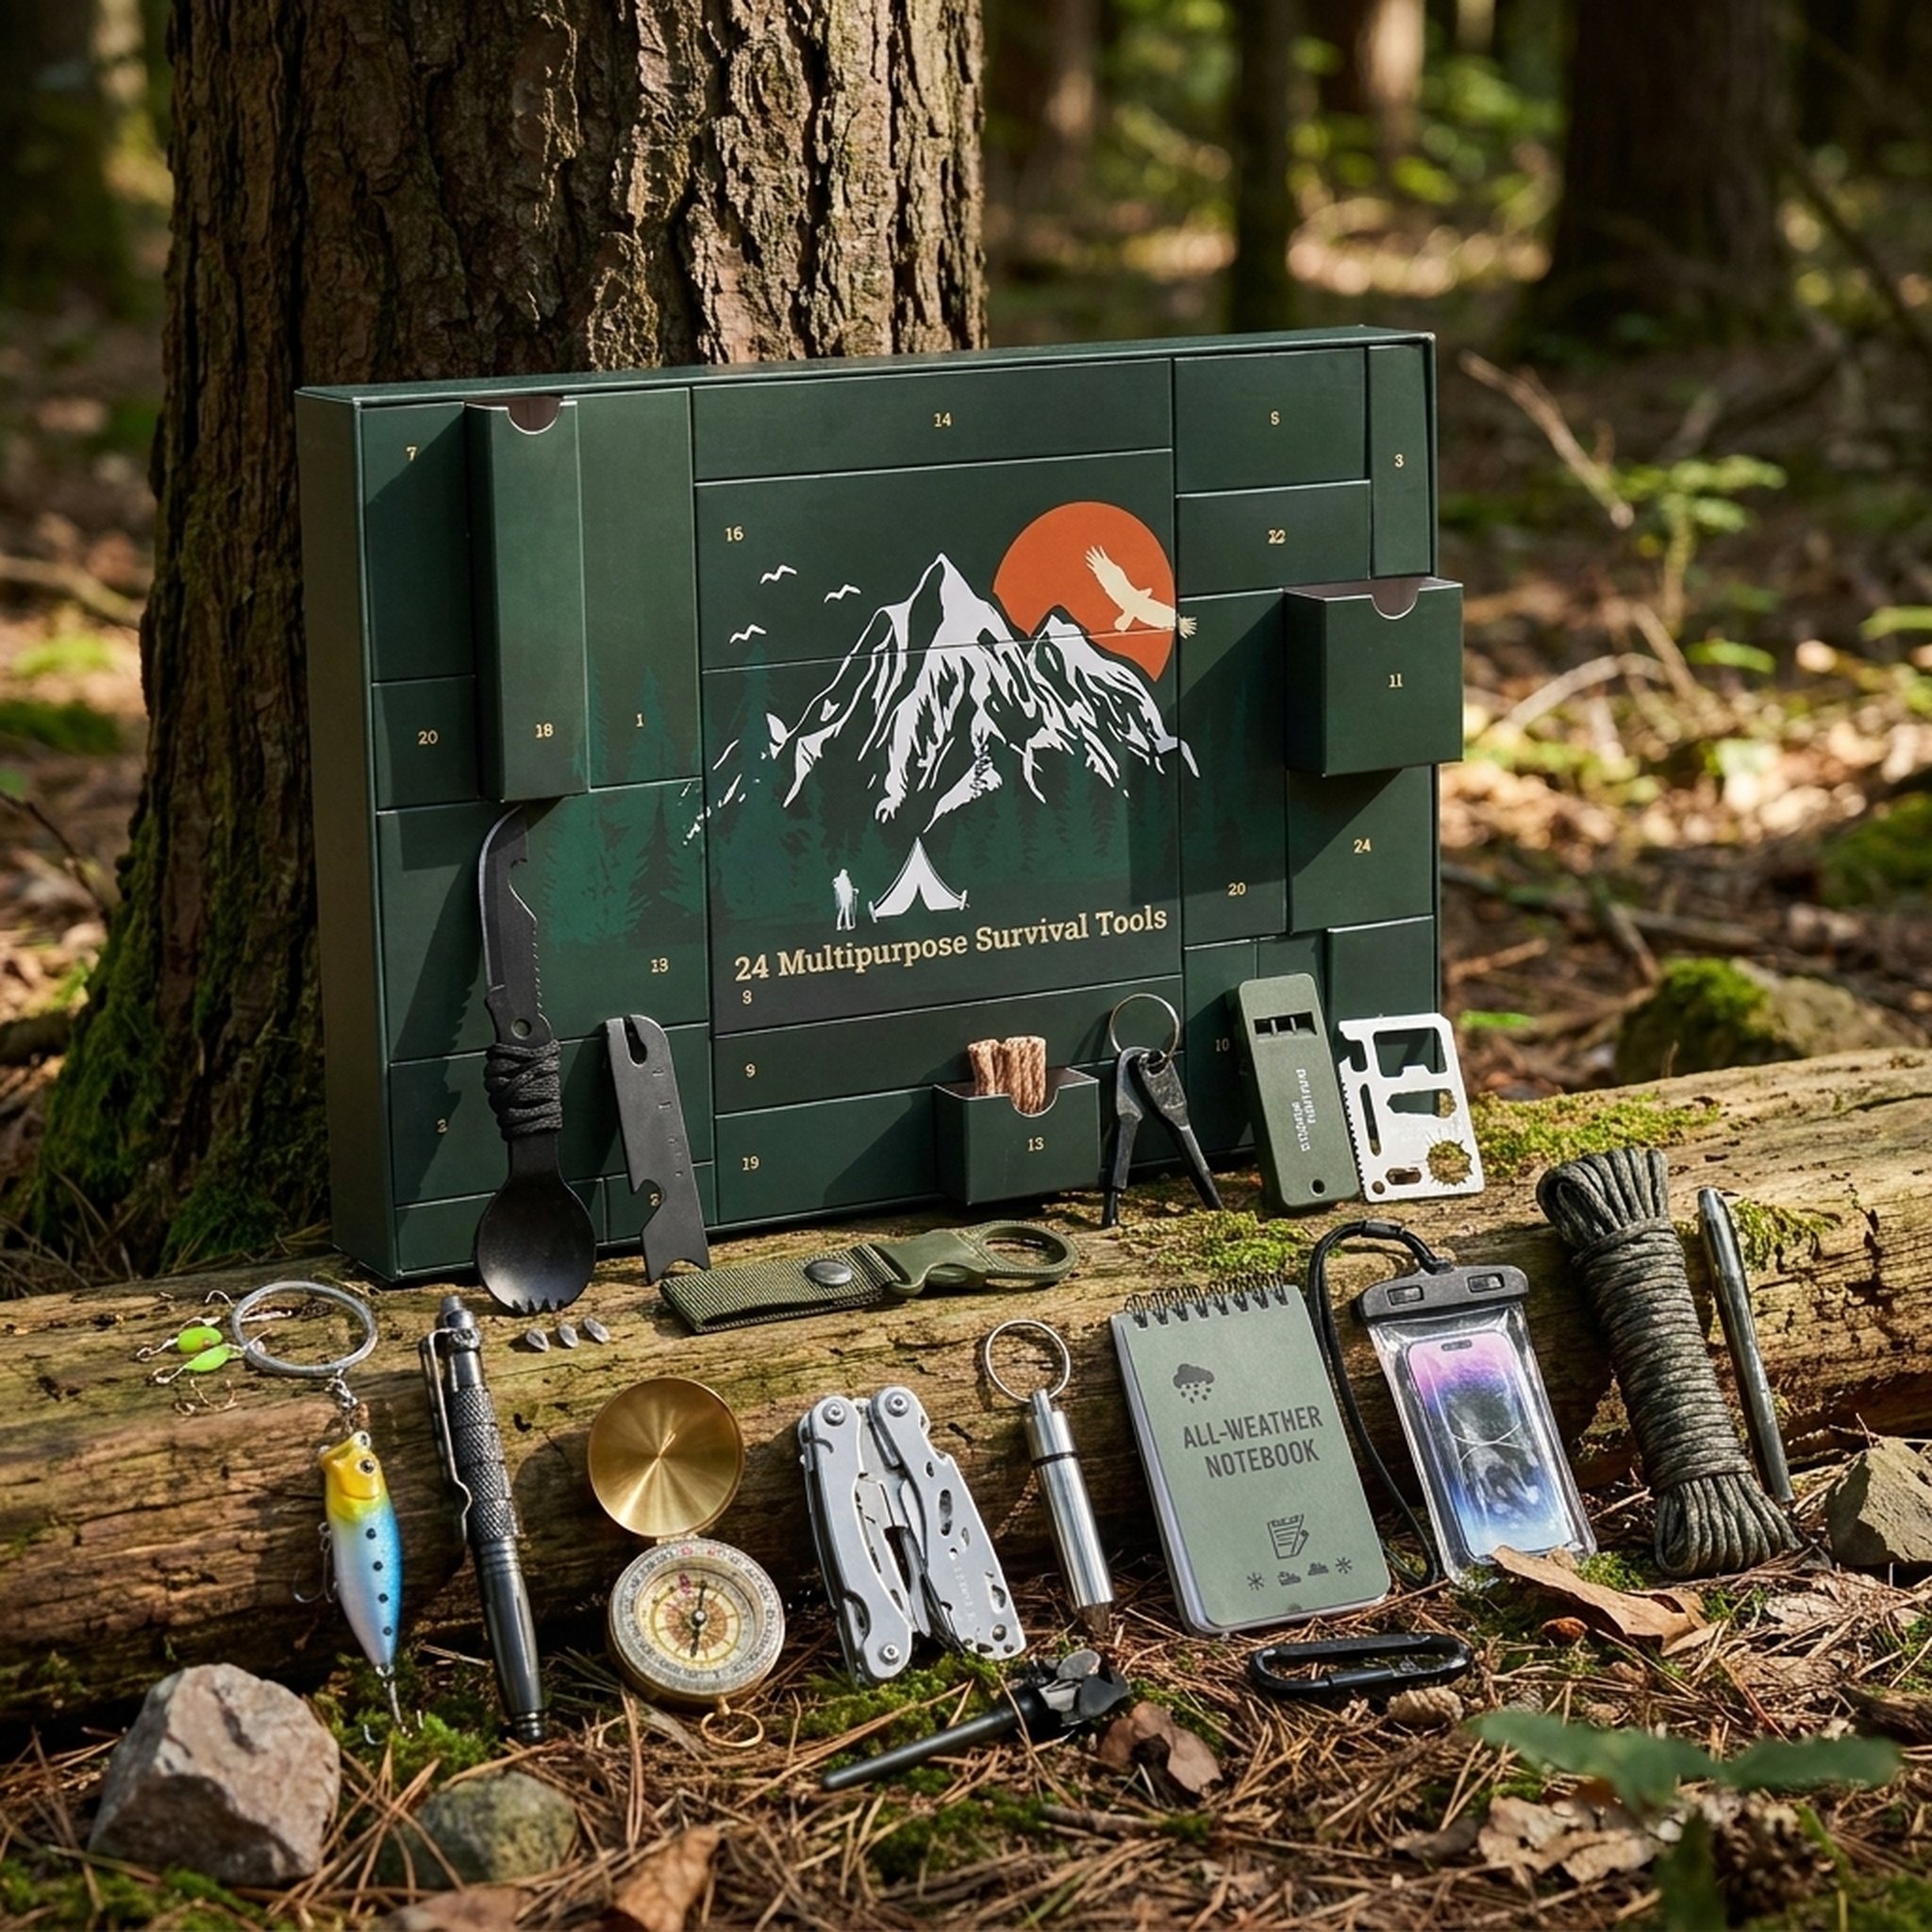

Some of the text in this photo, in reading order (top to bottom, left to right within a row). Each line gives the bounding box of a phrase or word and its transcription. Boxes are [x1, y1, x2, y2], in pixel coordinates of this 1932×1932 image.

[934, 411, 953, 427] 14
[406, 446, 418, 460] 7
[725, 525, 744, 541] 16
[1389, 673, 1403, 688] 11
[636, 714, 644, 727] 1
[418, 729, 439, 745] 20
[536, 723, 555, 739] 18
[1354, 839, 1372, 854] 24
[1228, 882, 1247, 896] 20
[734, 905, 1168, 981] 24 Multipurpose Survival Tools
[1215, 1038, 1230, 1052] 10
[745, 1063, 756, 1077] 9
[437, 1119, 448, 1133] 2
[742, 1156, 760, 1171] 19
[1184, 1405, 1324, 1449] ALL-WEATHER
[1205, 1439, 1320, 1478] NOTEBOOK
